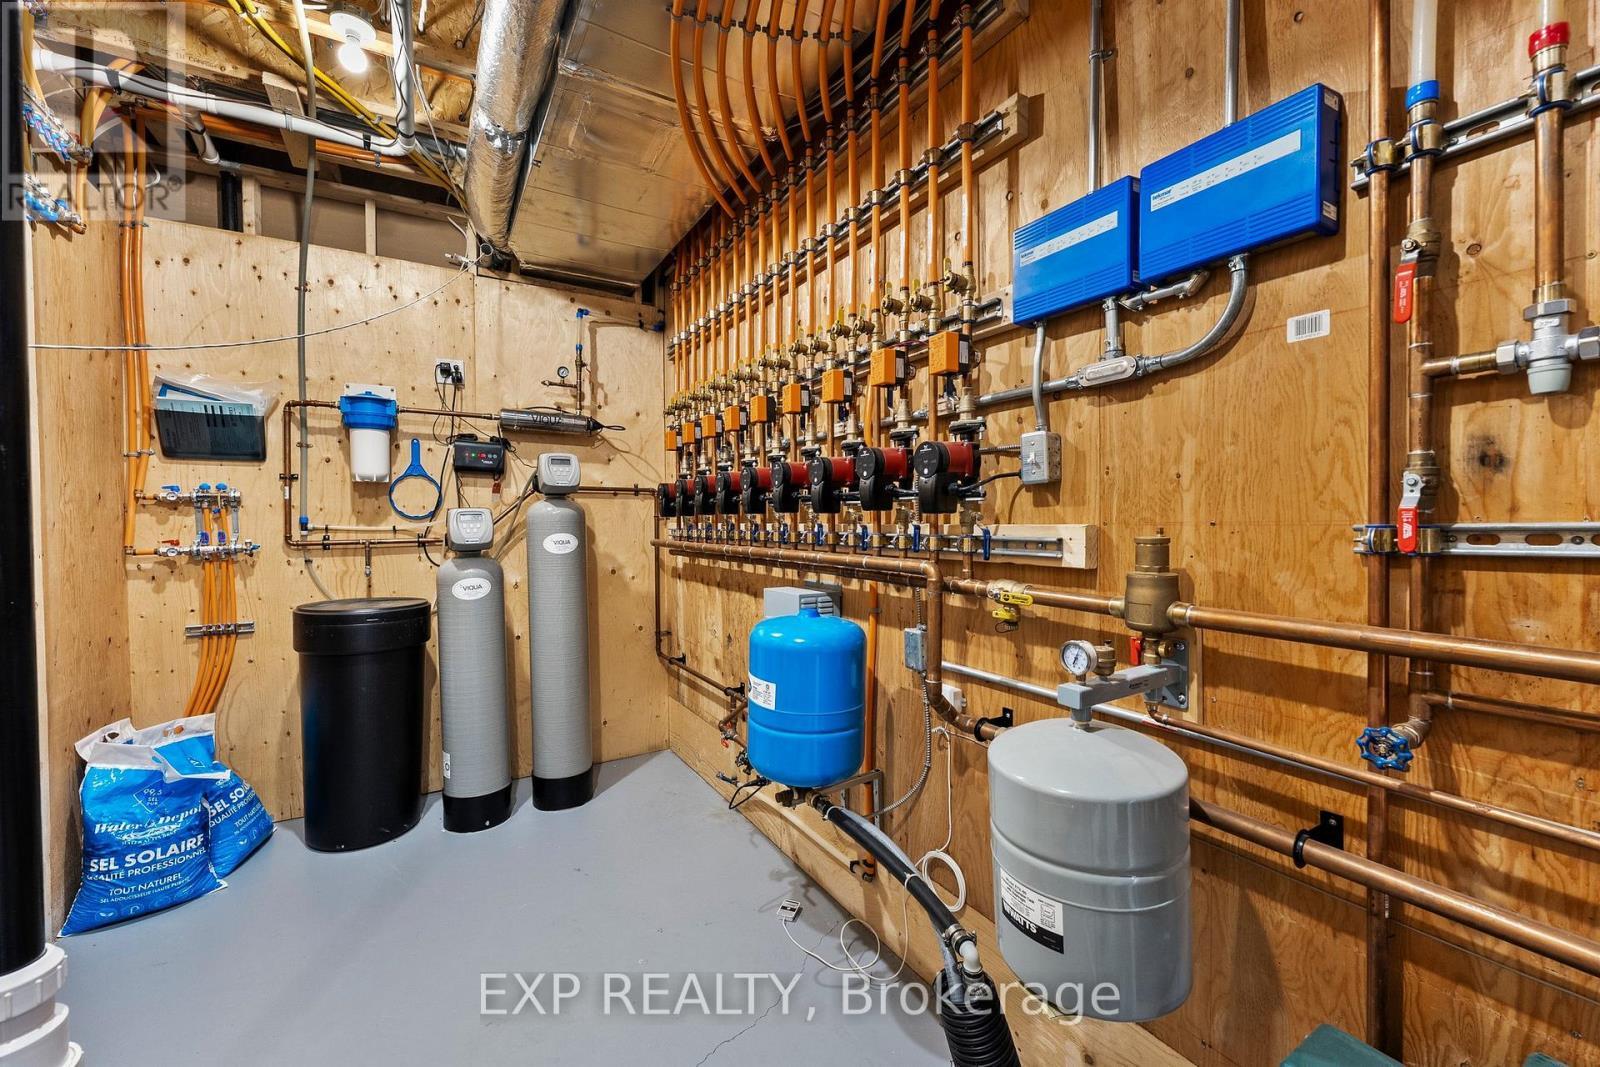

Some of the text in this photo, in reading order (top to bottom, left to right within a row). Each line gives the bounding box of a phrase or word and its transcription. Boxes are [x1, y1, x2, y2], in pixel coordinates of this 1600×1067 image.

[90, 857, 119, 872] SEL
[127, 847, 206, 877] PROFESSIONNEL
[109, 873, 182, 896] TOUT NATUREL
